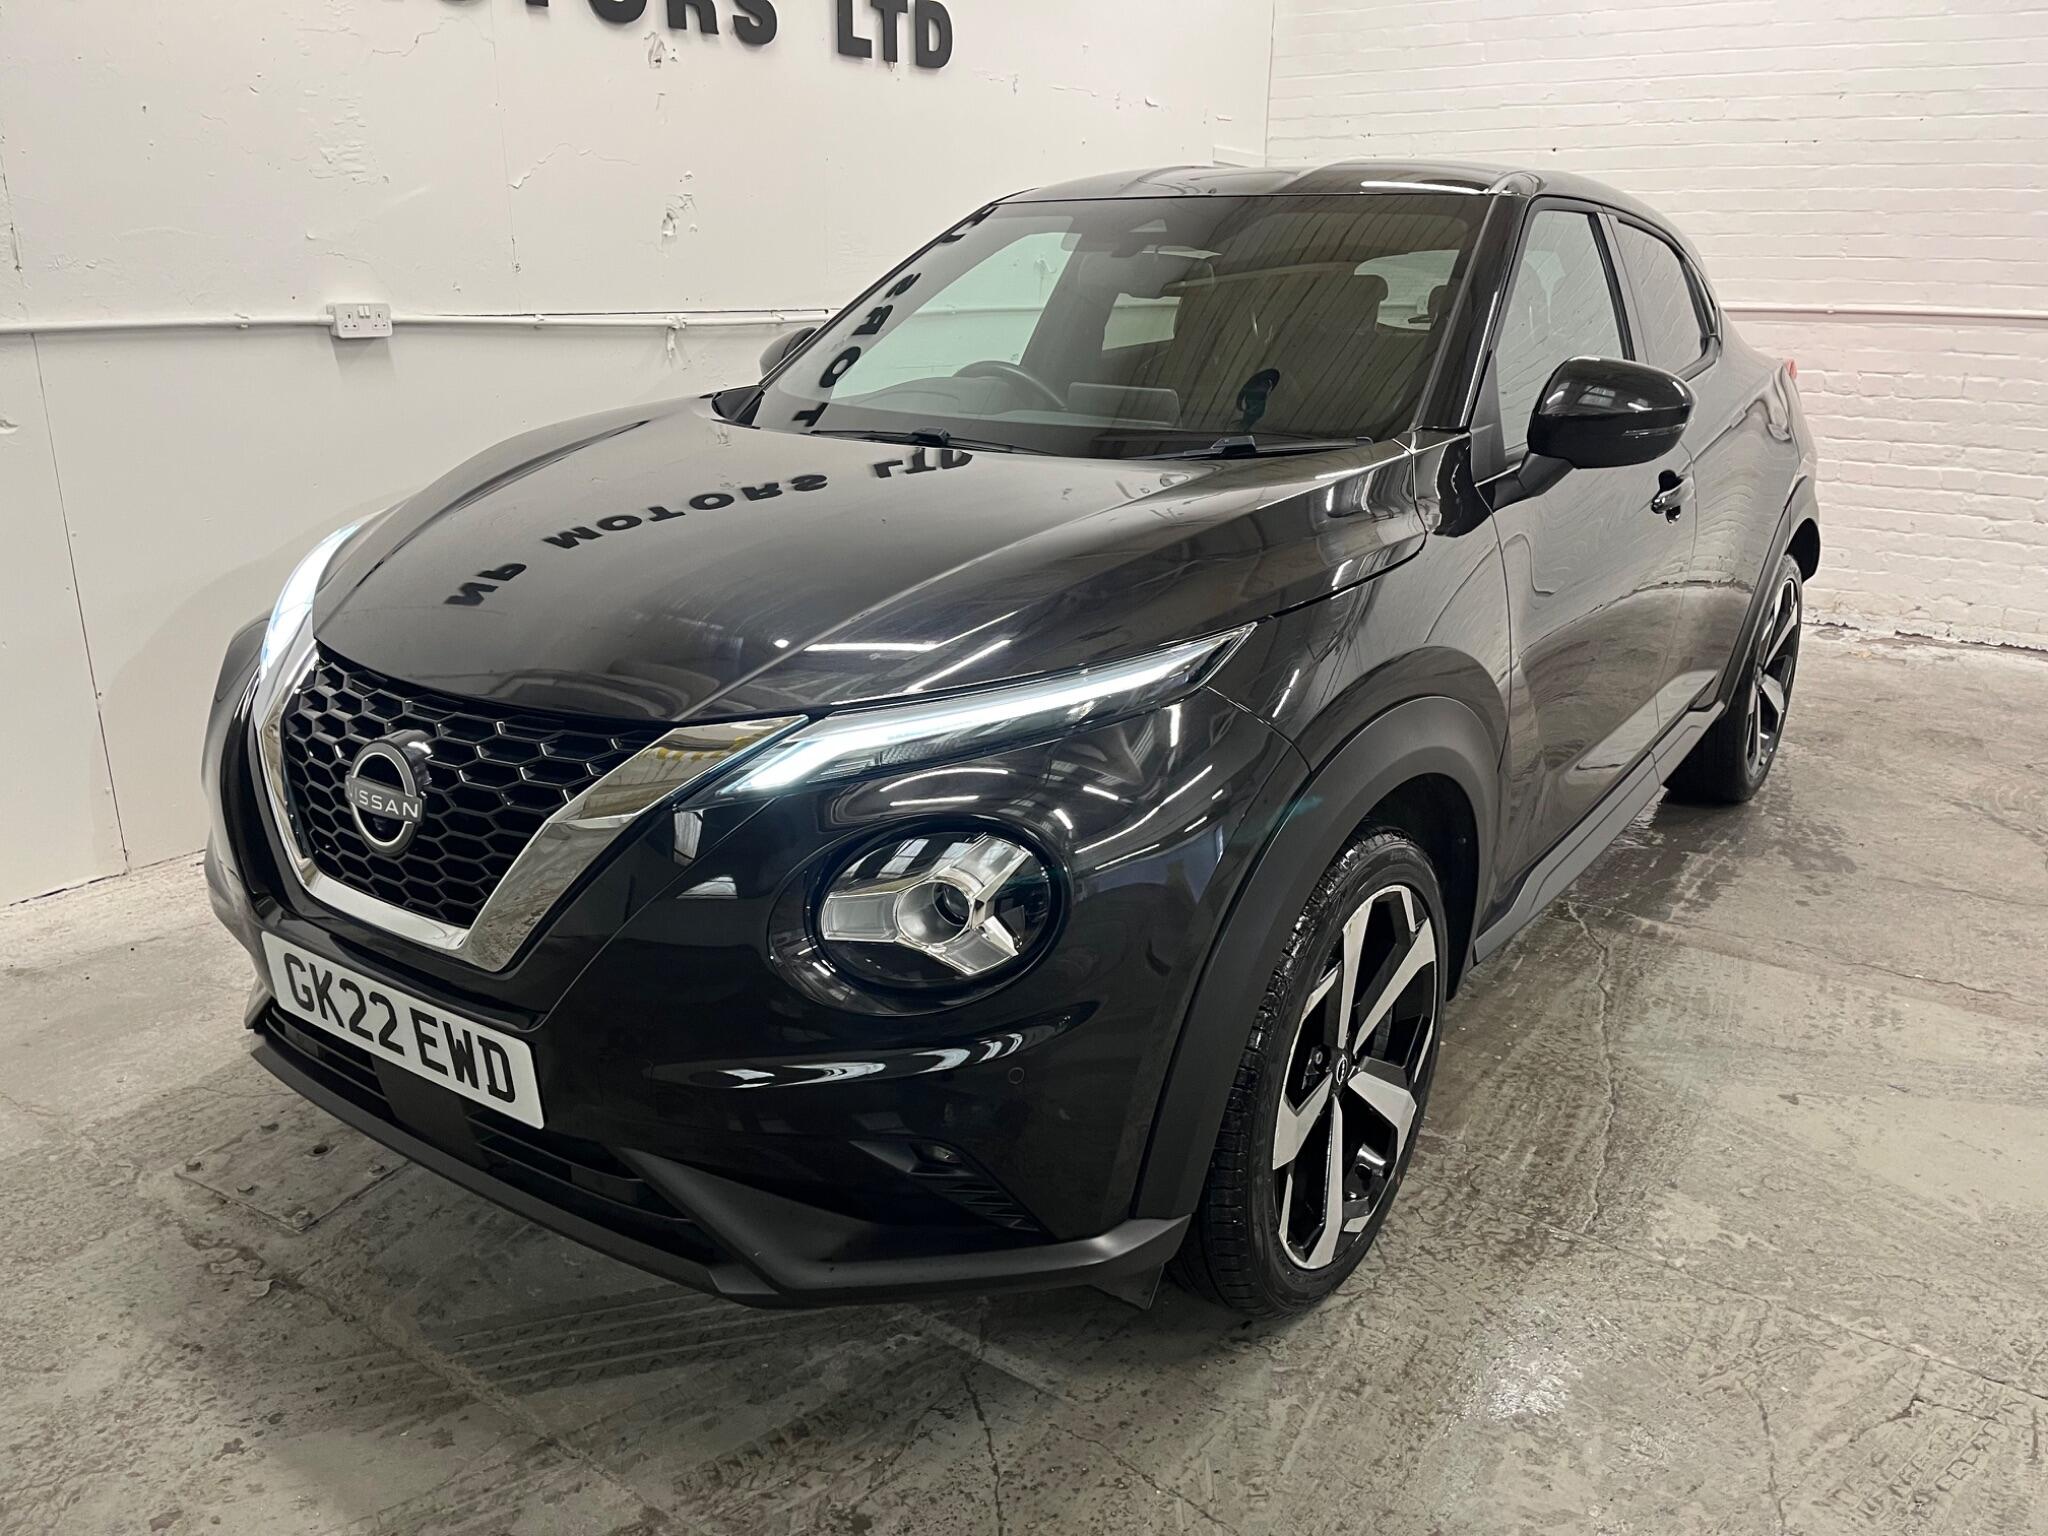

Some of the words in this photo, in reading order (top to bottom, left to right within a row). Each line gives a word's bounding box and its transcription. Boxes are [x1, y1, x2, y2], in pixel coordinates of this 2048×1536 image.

[837, 0, 953, 69] LTD
[283, 952, 405, 1057] GK22
[409, 1006, 517, 1104] EWD
